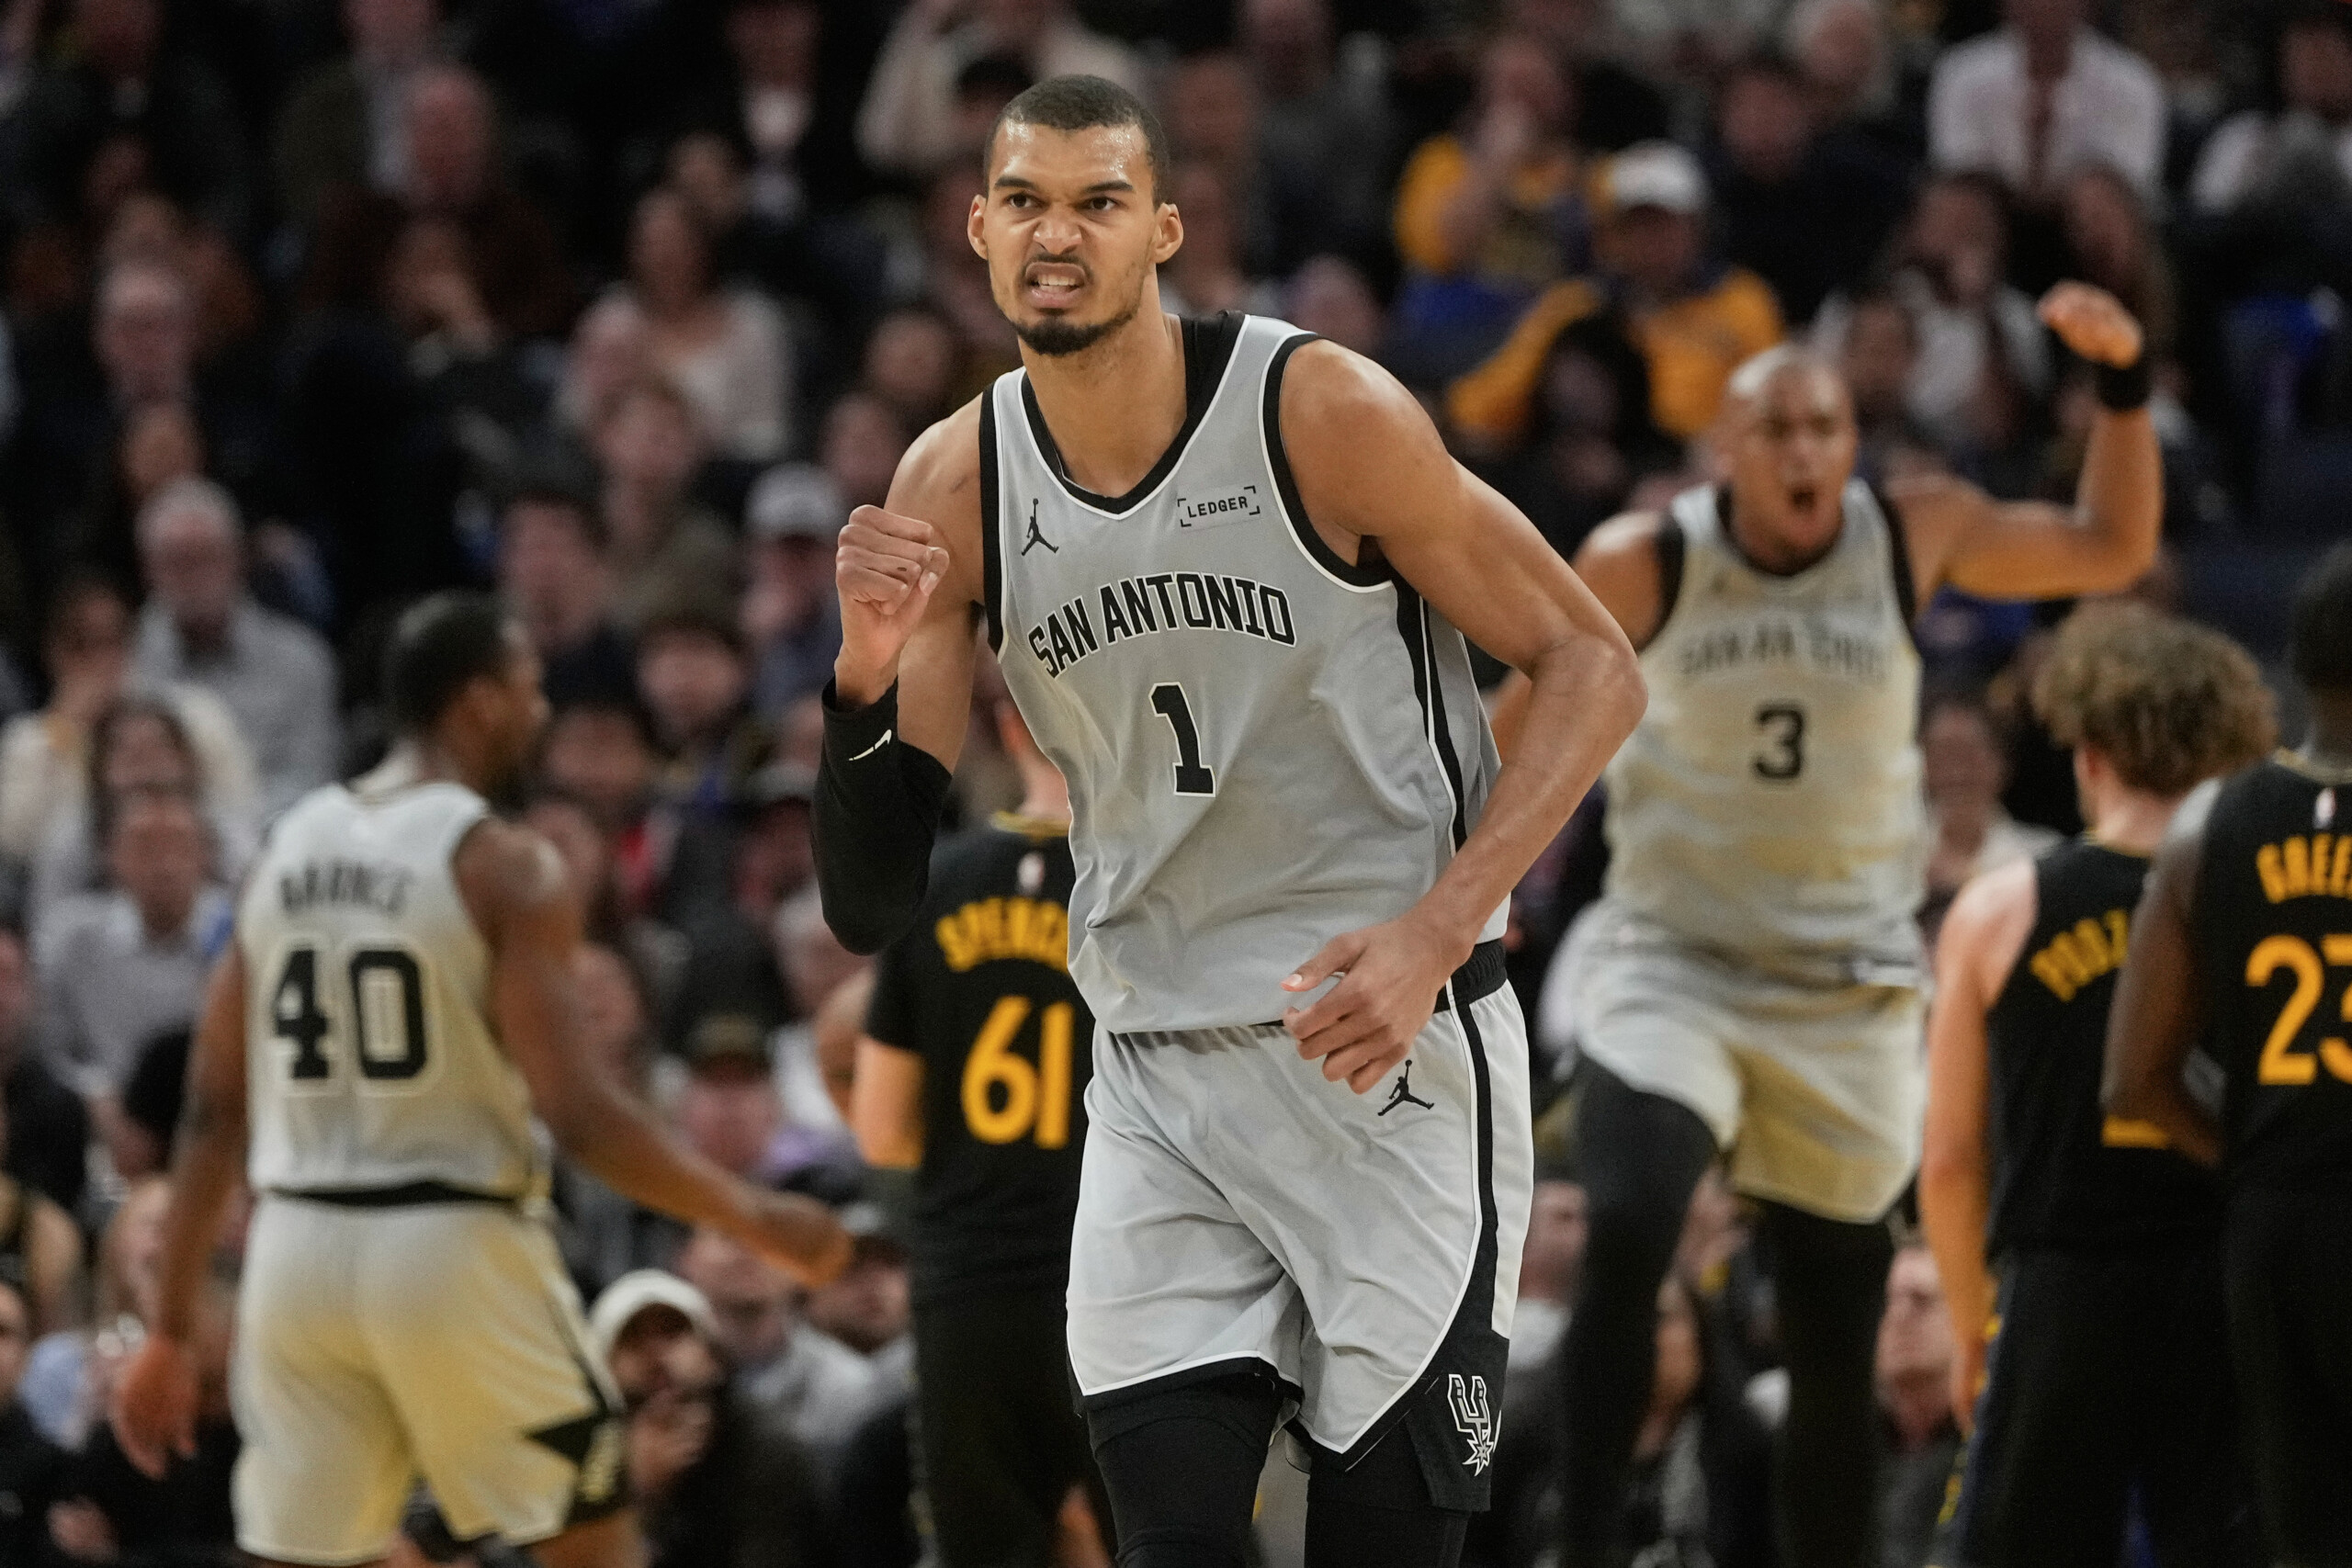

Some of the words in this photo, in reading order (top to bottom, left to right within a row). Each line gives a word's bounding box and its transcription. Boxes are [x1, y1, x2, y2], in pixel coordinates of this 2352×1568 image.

[1187, 496, 1249, 518] LEDGER
[1027, 595, 1100, 679] SAN
[1098, 571, 1296, 648] ANTONIO
[1148, 682, 1216, 797] 1
[1753, 704, 1804, 781] 3
[274, 947, 428, 1080] 40
[960, 993, 1075, 1150] 61
